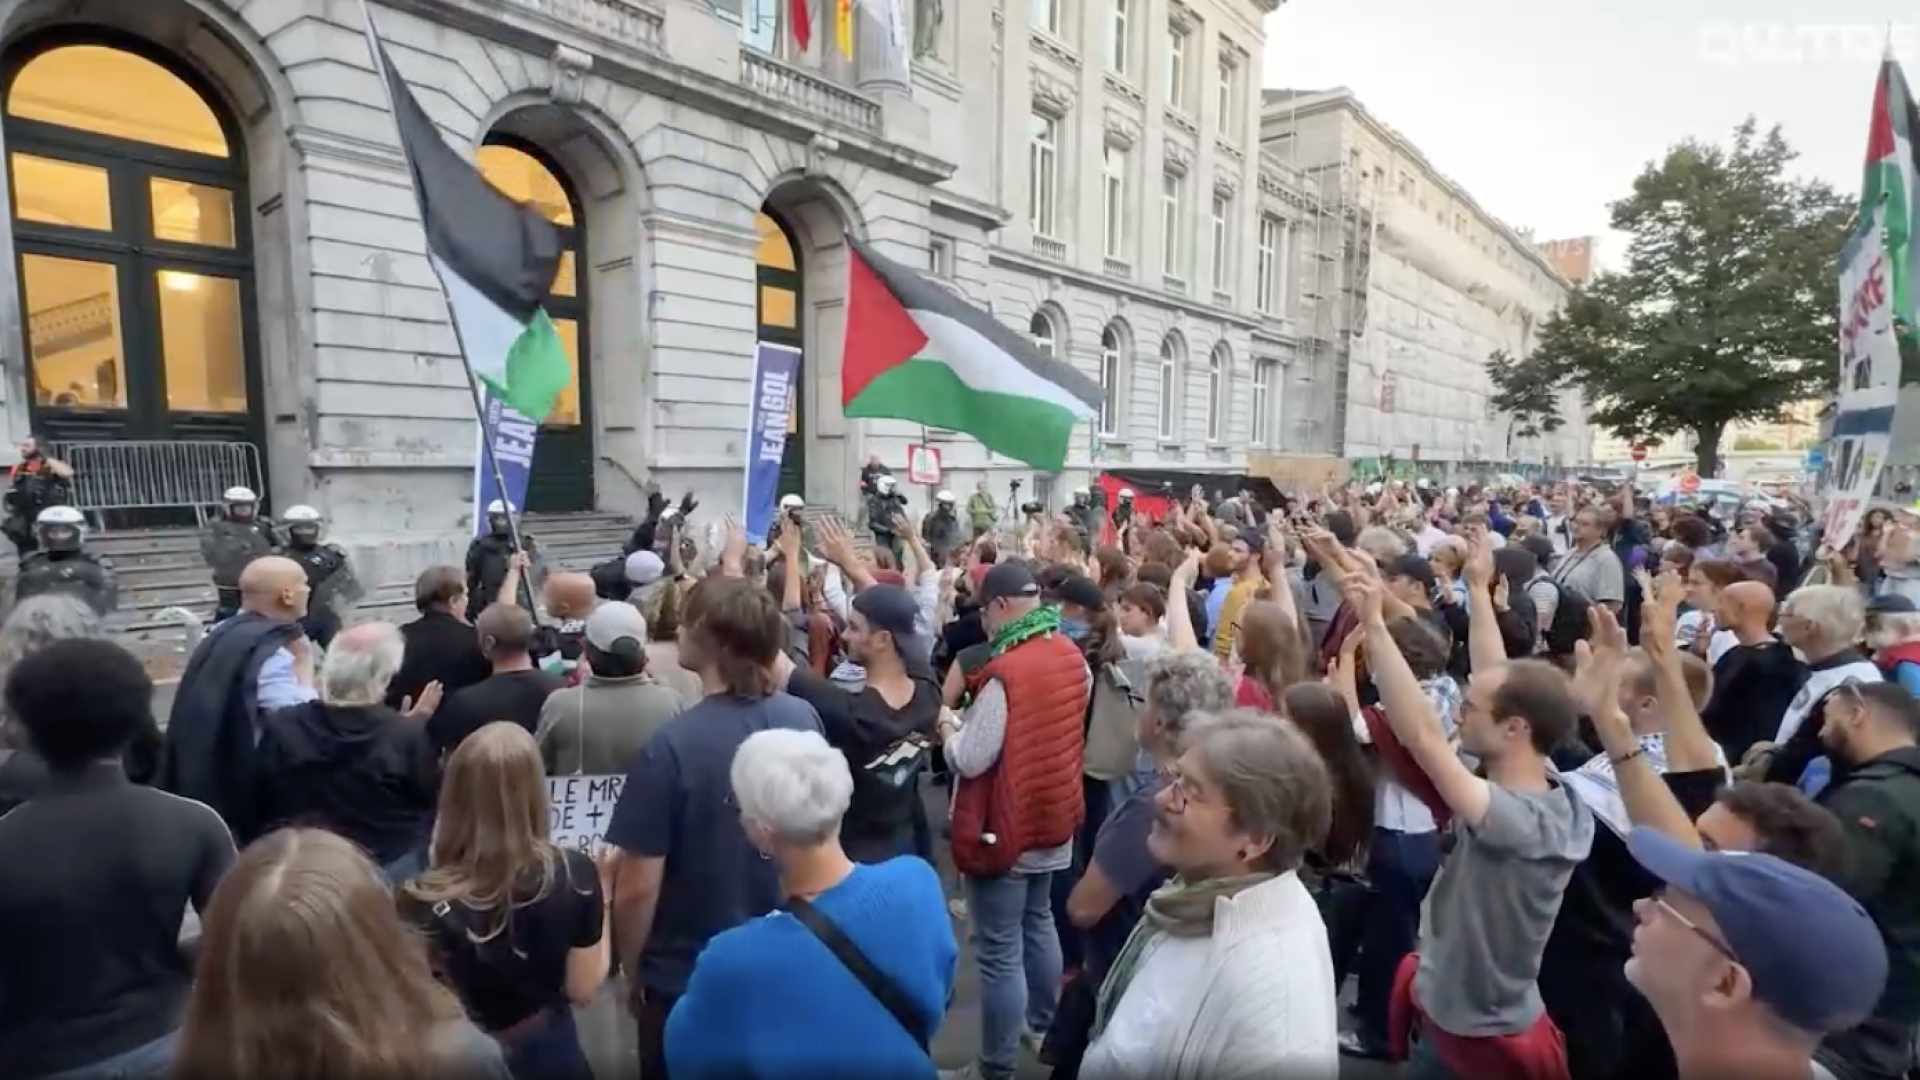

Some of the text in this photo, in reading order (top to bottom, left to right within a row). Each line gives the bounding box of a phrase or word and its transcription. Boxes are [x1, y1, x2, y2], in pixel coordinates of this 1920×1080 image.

[760, 371, 790, 464] JEAN GOL
[588, 777, 622, 803] MR
